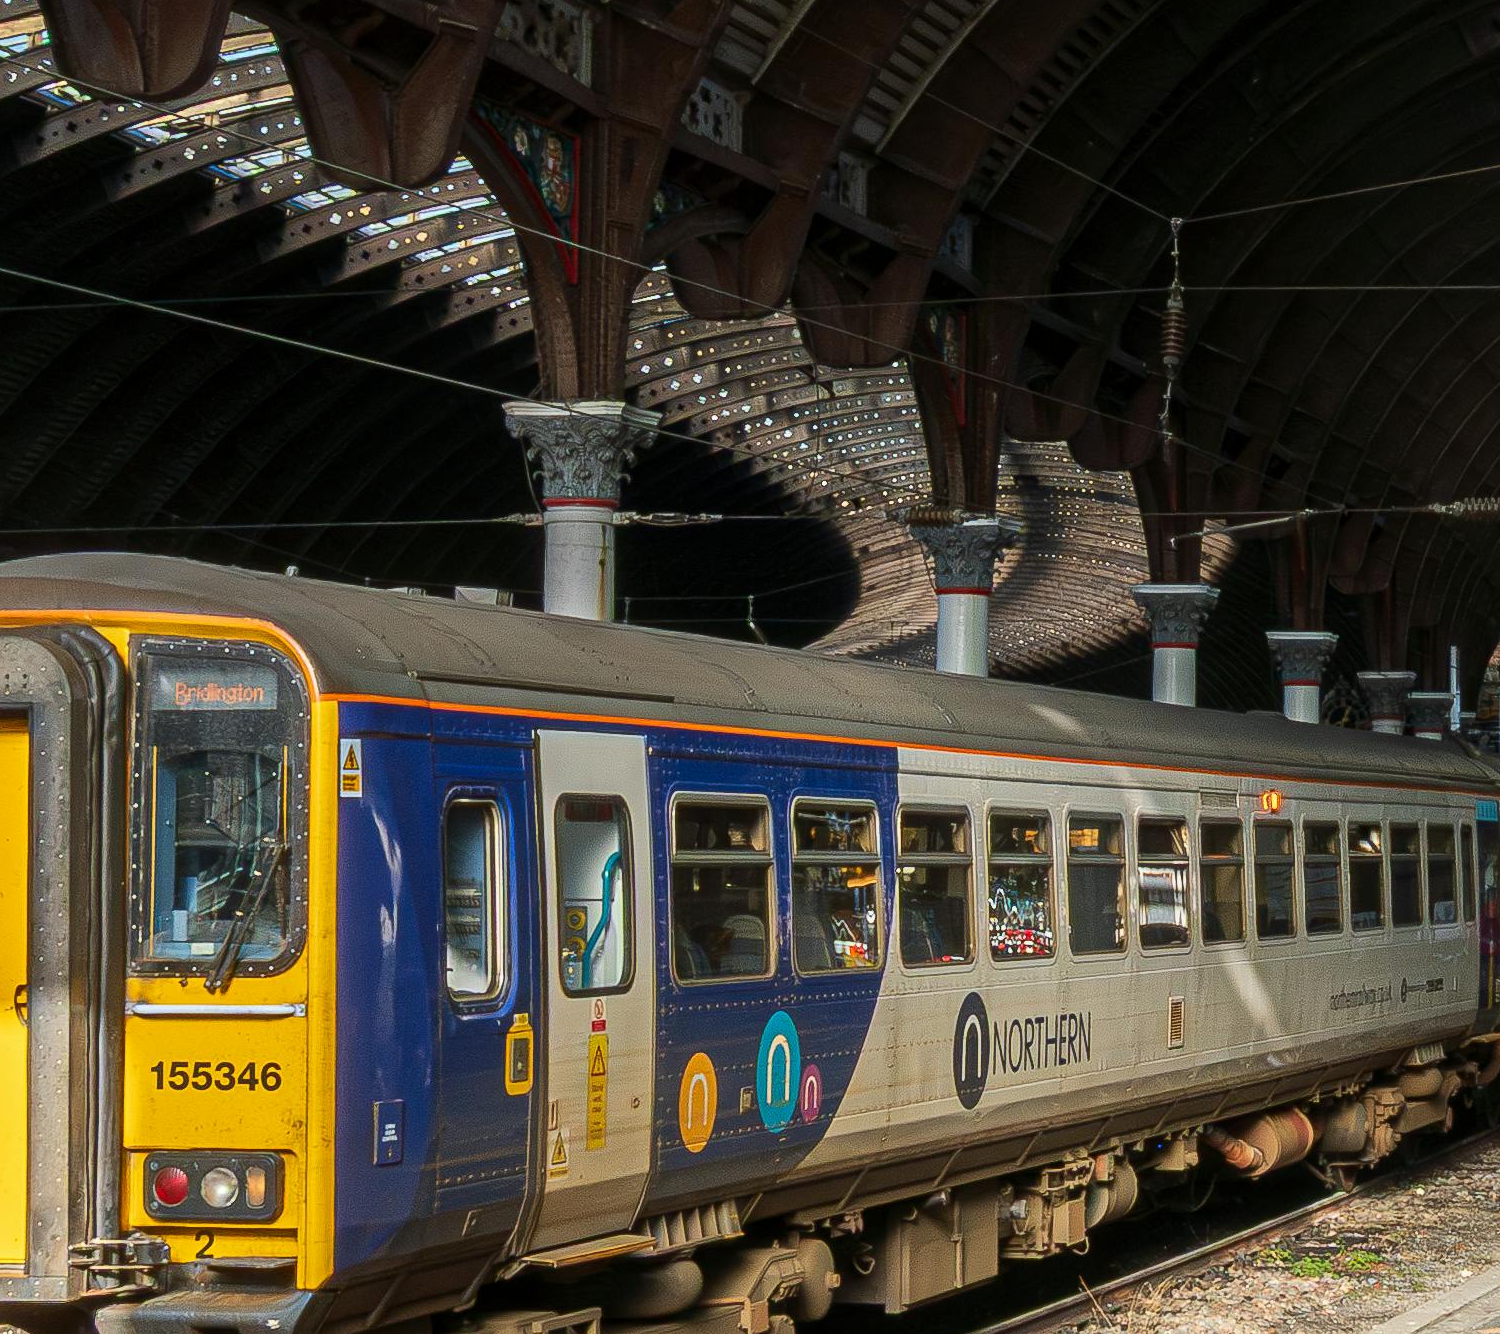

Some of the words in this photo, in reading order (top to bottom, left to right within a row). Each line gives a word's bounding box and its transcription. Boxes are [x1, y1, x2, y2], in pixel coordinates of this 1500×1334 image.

[175, 682, 264, 705] Bridlington
[993, 1011, 1091, 1076] NORTHERN
[150, 1060, 282, 1092] 155346
[195, 1230, 215, 1259] 2
